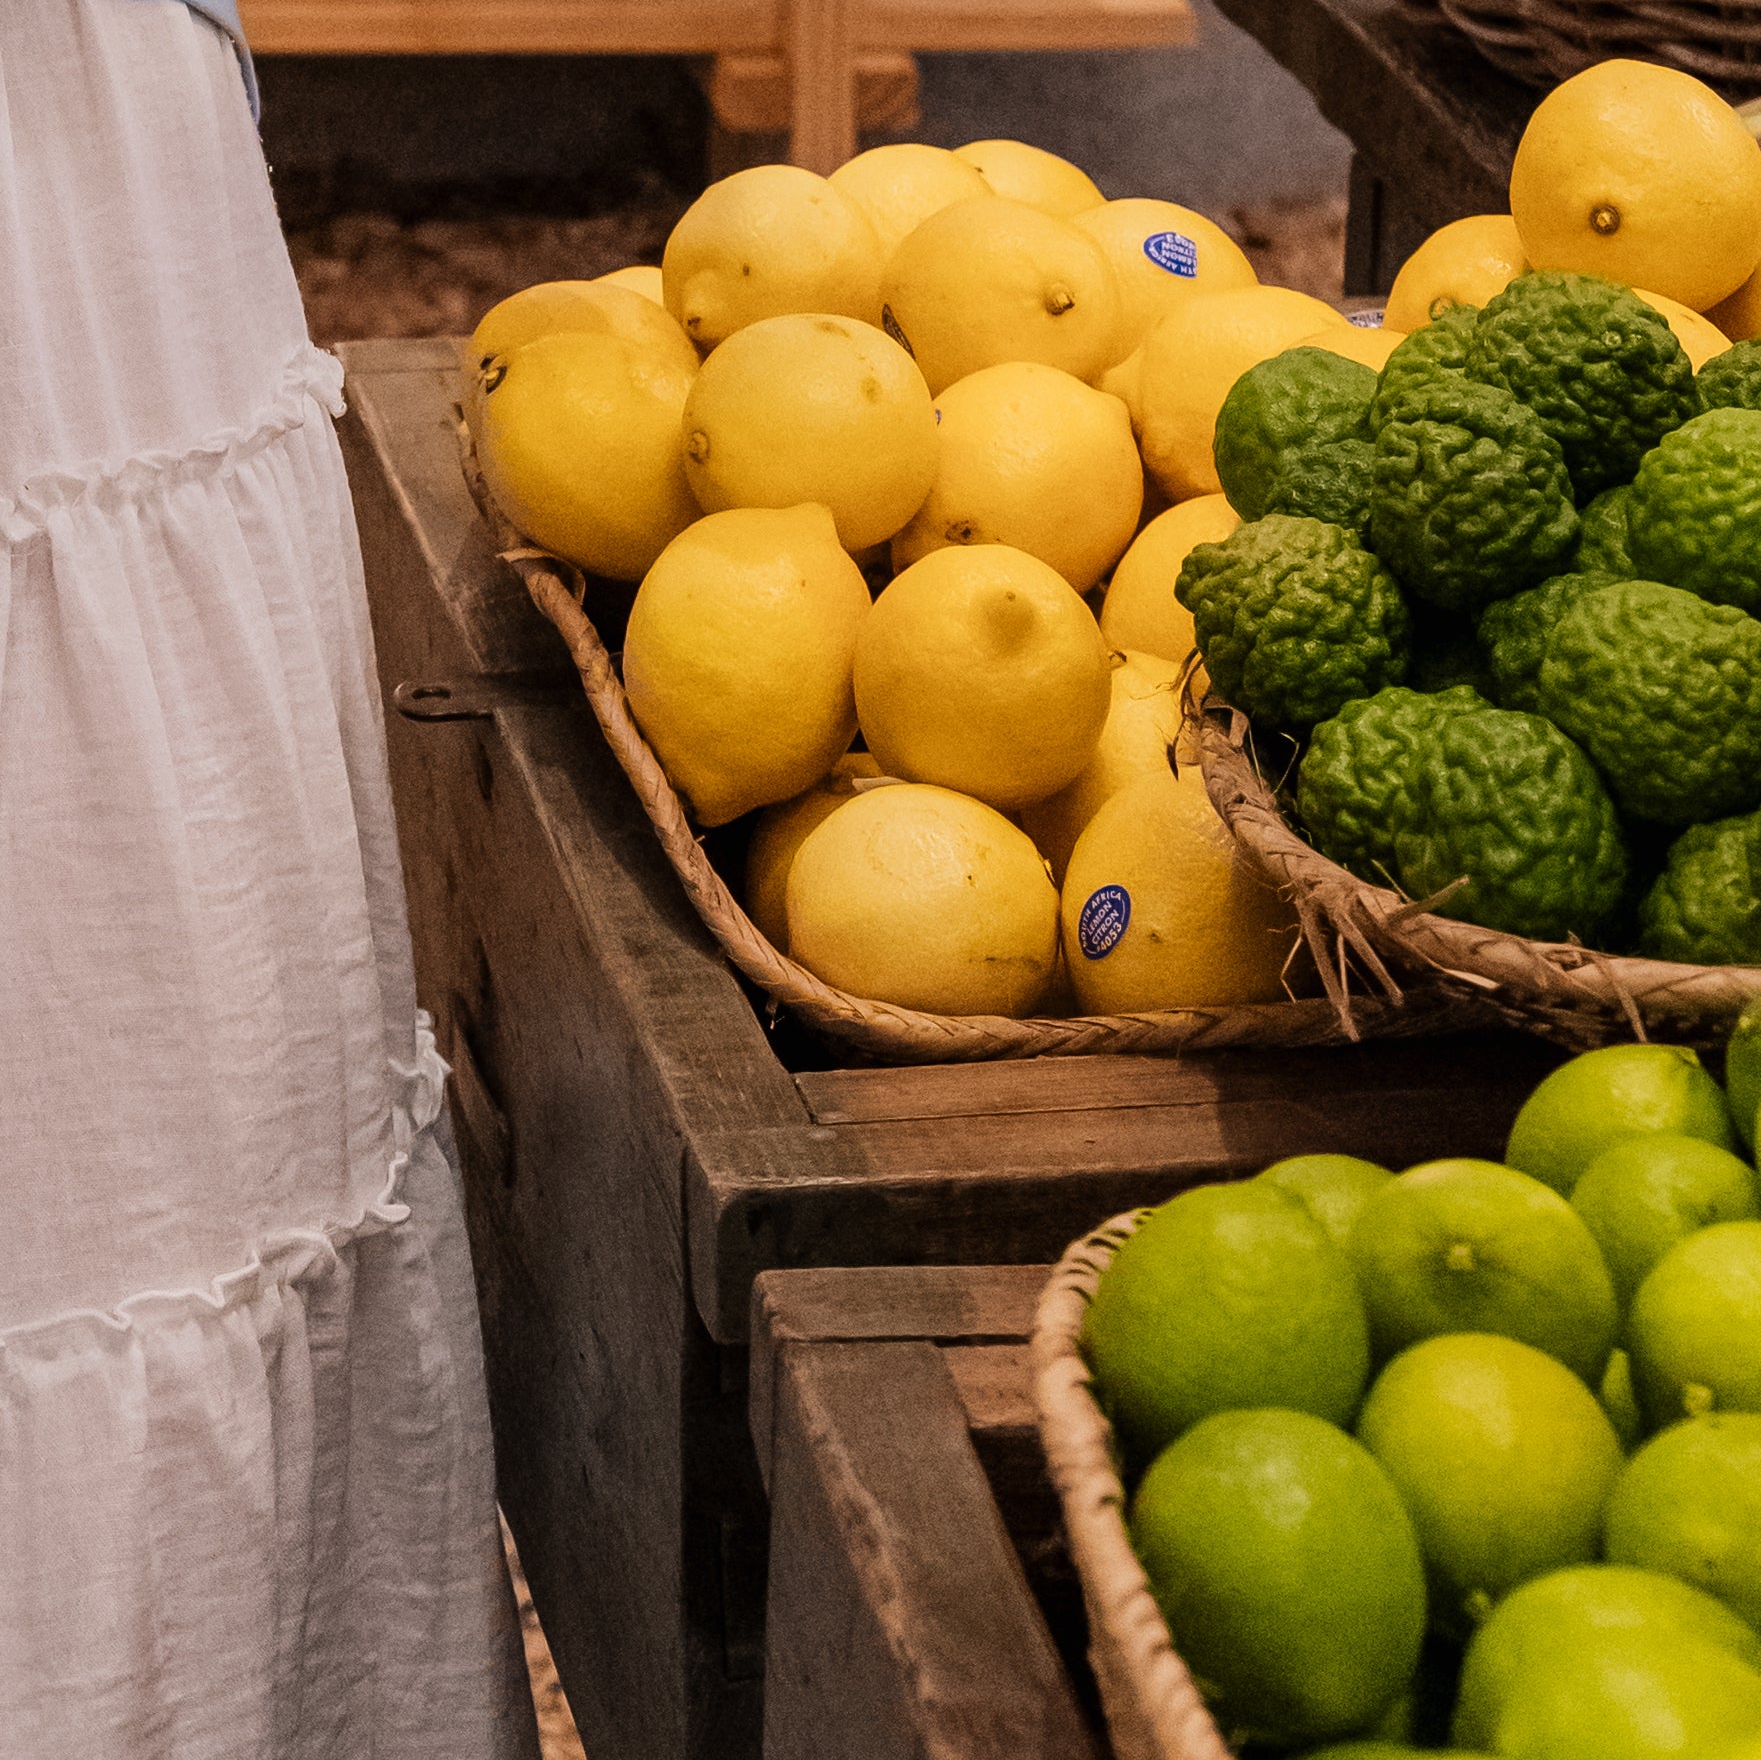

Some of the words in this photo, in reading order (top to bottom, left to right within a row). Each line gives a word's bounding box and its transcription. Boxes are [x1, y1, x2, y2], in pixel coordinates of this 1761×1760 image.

[1091, 891, 1121, 909] AFRICA
[1087, 901, 1112, 936] LEMON
[1092, 909, 1119, 945] CITRON
